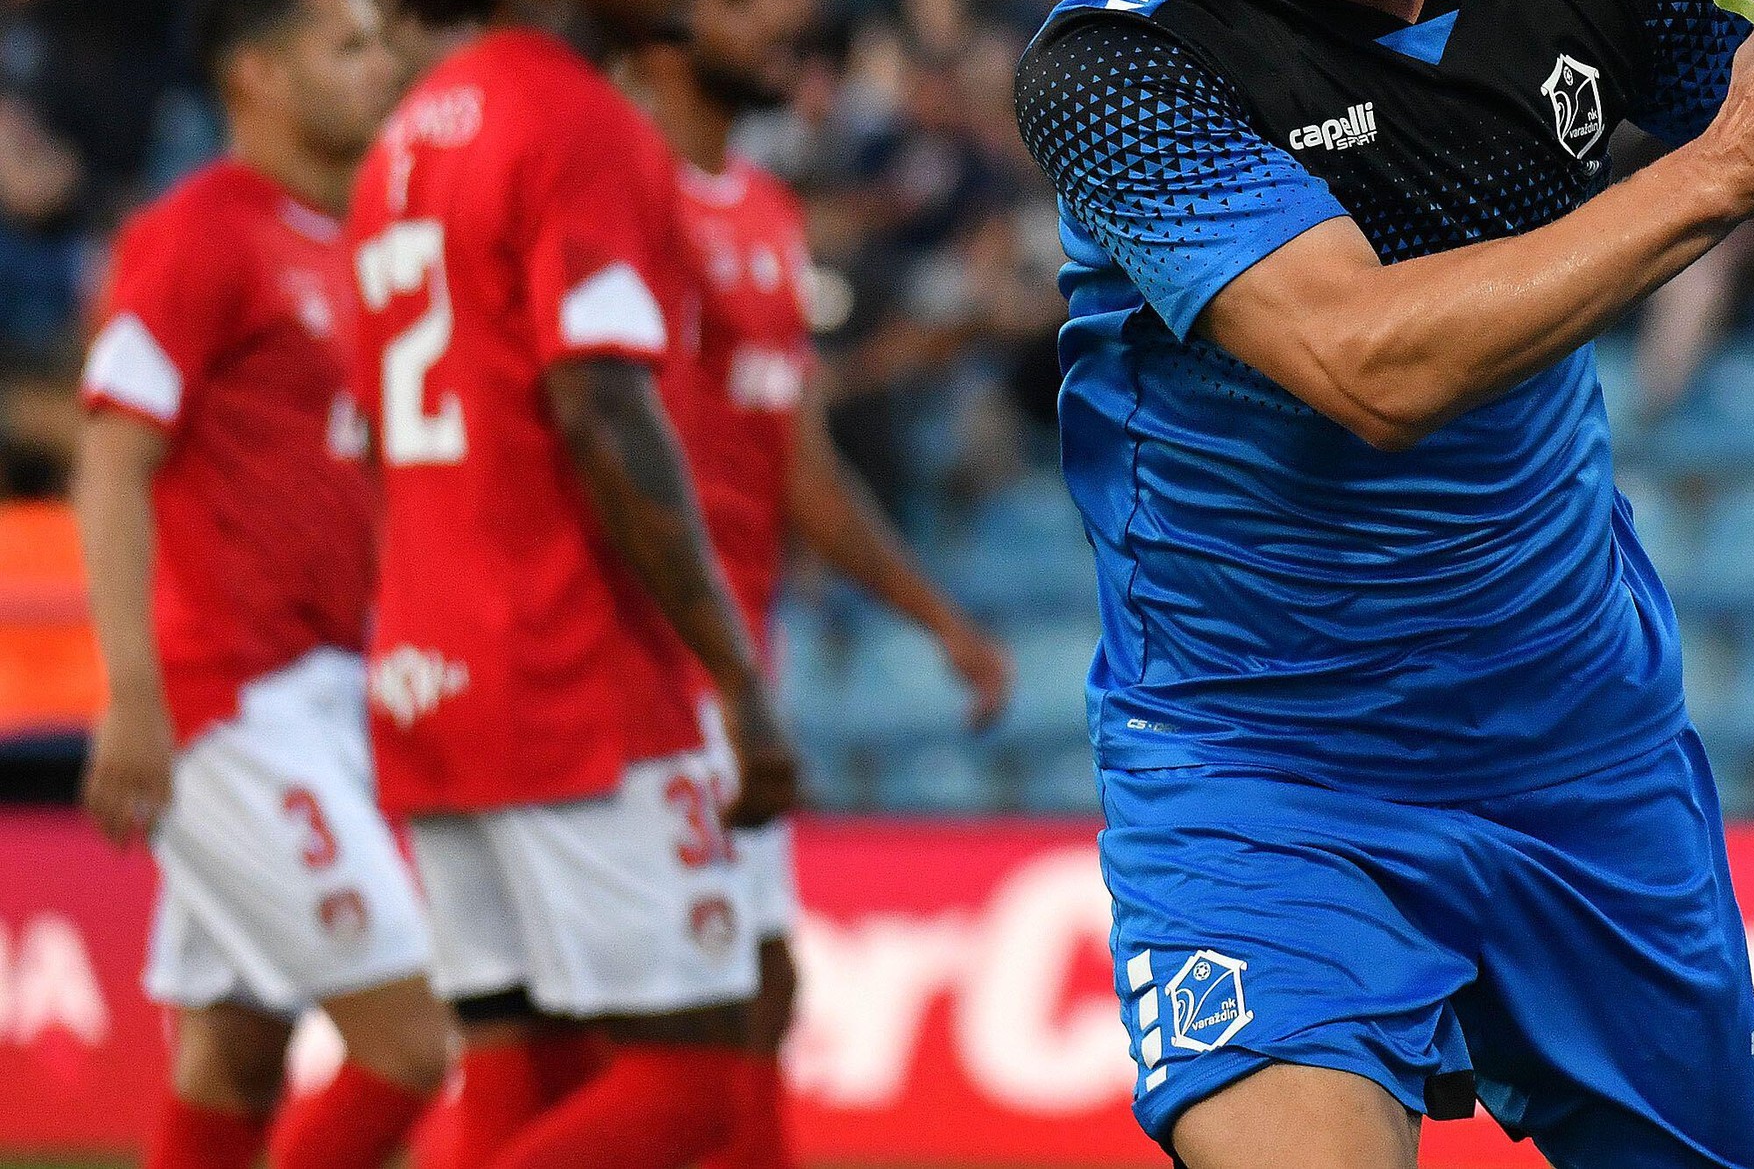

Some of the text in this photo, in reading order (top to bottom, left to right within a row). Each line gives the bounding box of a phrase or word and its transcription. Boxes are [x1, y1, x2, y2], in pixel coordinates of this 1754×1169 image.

[1289, 101, 1377, 151] capelli
[282, 784, 337, 871] 3
[1191, 1009, 1238, 1031] varaždin
[1221, 997, 1236, 1010] nk
